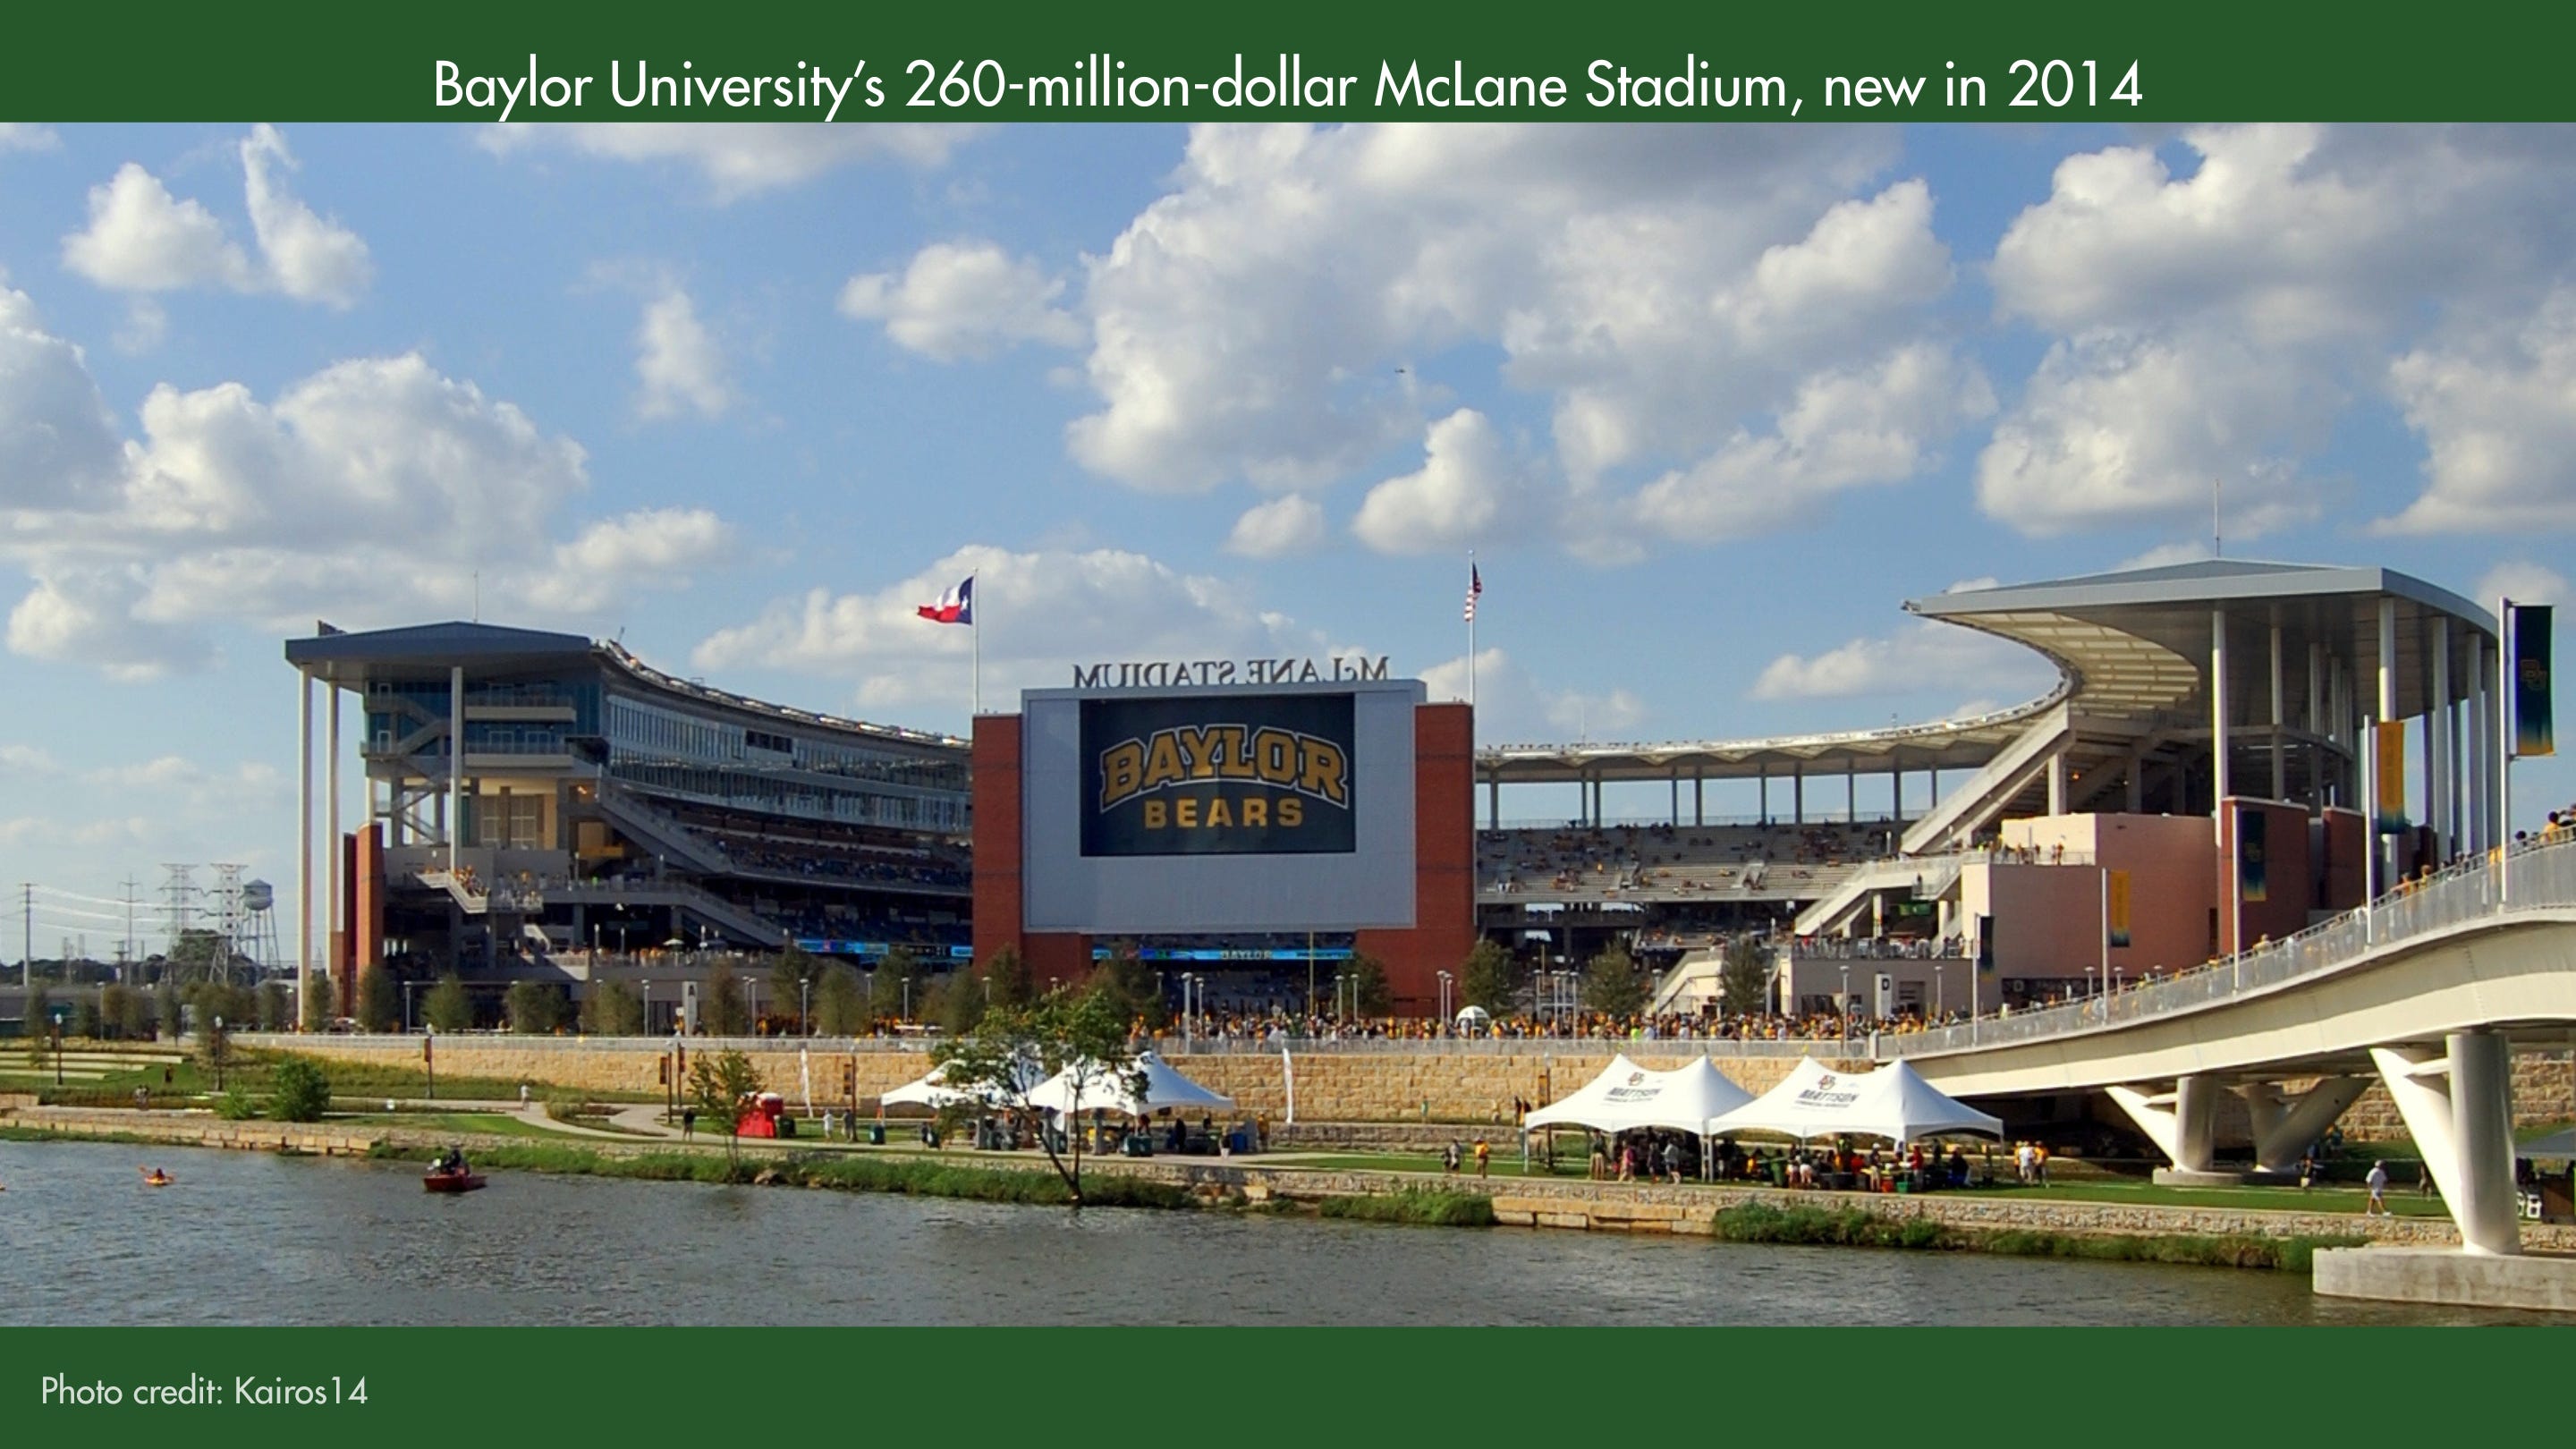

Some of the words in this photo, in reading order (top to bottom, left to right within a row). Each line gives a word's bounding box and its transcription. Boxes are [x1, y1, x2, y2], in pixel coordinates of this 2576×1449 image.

[1100, 724, 1349, 814] BAYLOR
[1144, 796, 1304, 829] BEARS
[1220, 949, 1273, 961] BAYLOR
[1799, 1089, 1860, 1103] MATTSON
